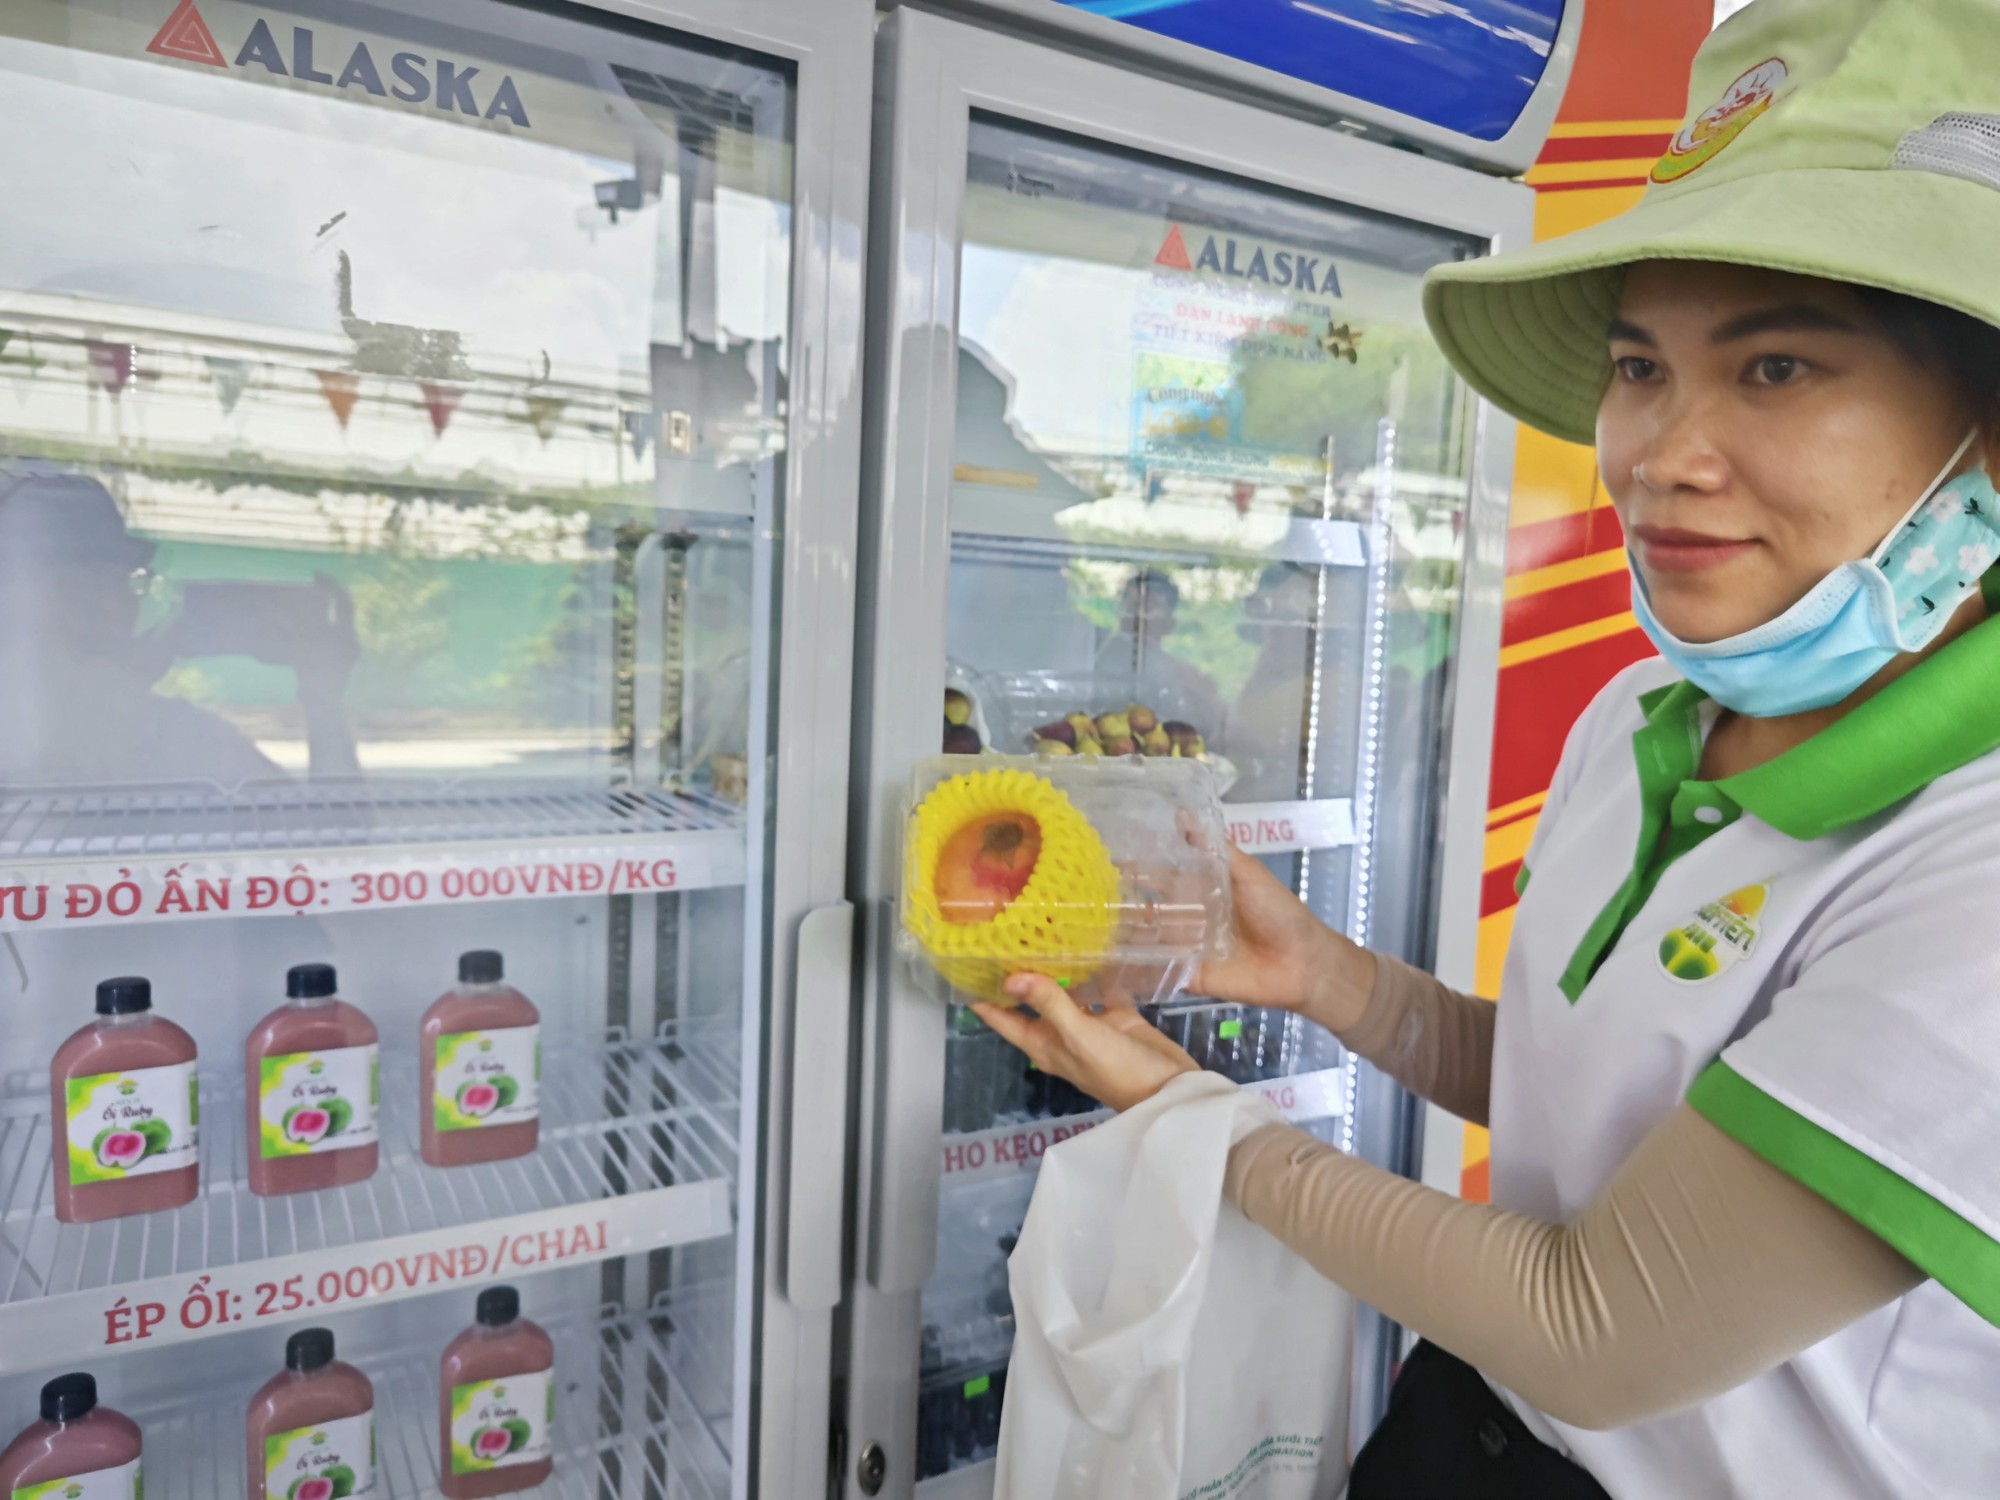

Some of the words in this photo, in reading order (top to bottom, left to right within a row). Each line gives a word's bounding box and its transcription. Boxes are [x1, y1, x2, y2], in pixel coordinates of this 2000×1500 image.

[234, 18, 532, 128] ALASKA
[1196, 235, 1342, 298] ALASKA
[65, 868, 142, 918] ĐỎ
[155, 863, 231, 914] ẤN
[246, 864, 329, 916] ĐỘ:
[351, 871, 428, 903] 300
[441, 859, 677, 898] 000VNĐ/KG
[122, 1104, 153, 1119] Ruby
[104, 1297, 165, 1345] ÉP
[180, 1275, 243, 1328] ỔI:
[255, 1221, 609, 1318] 25.000VNĐ/CHAI
